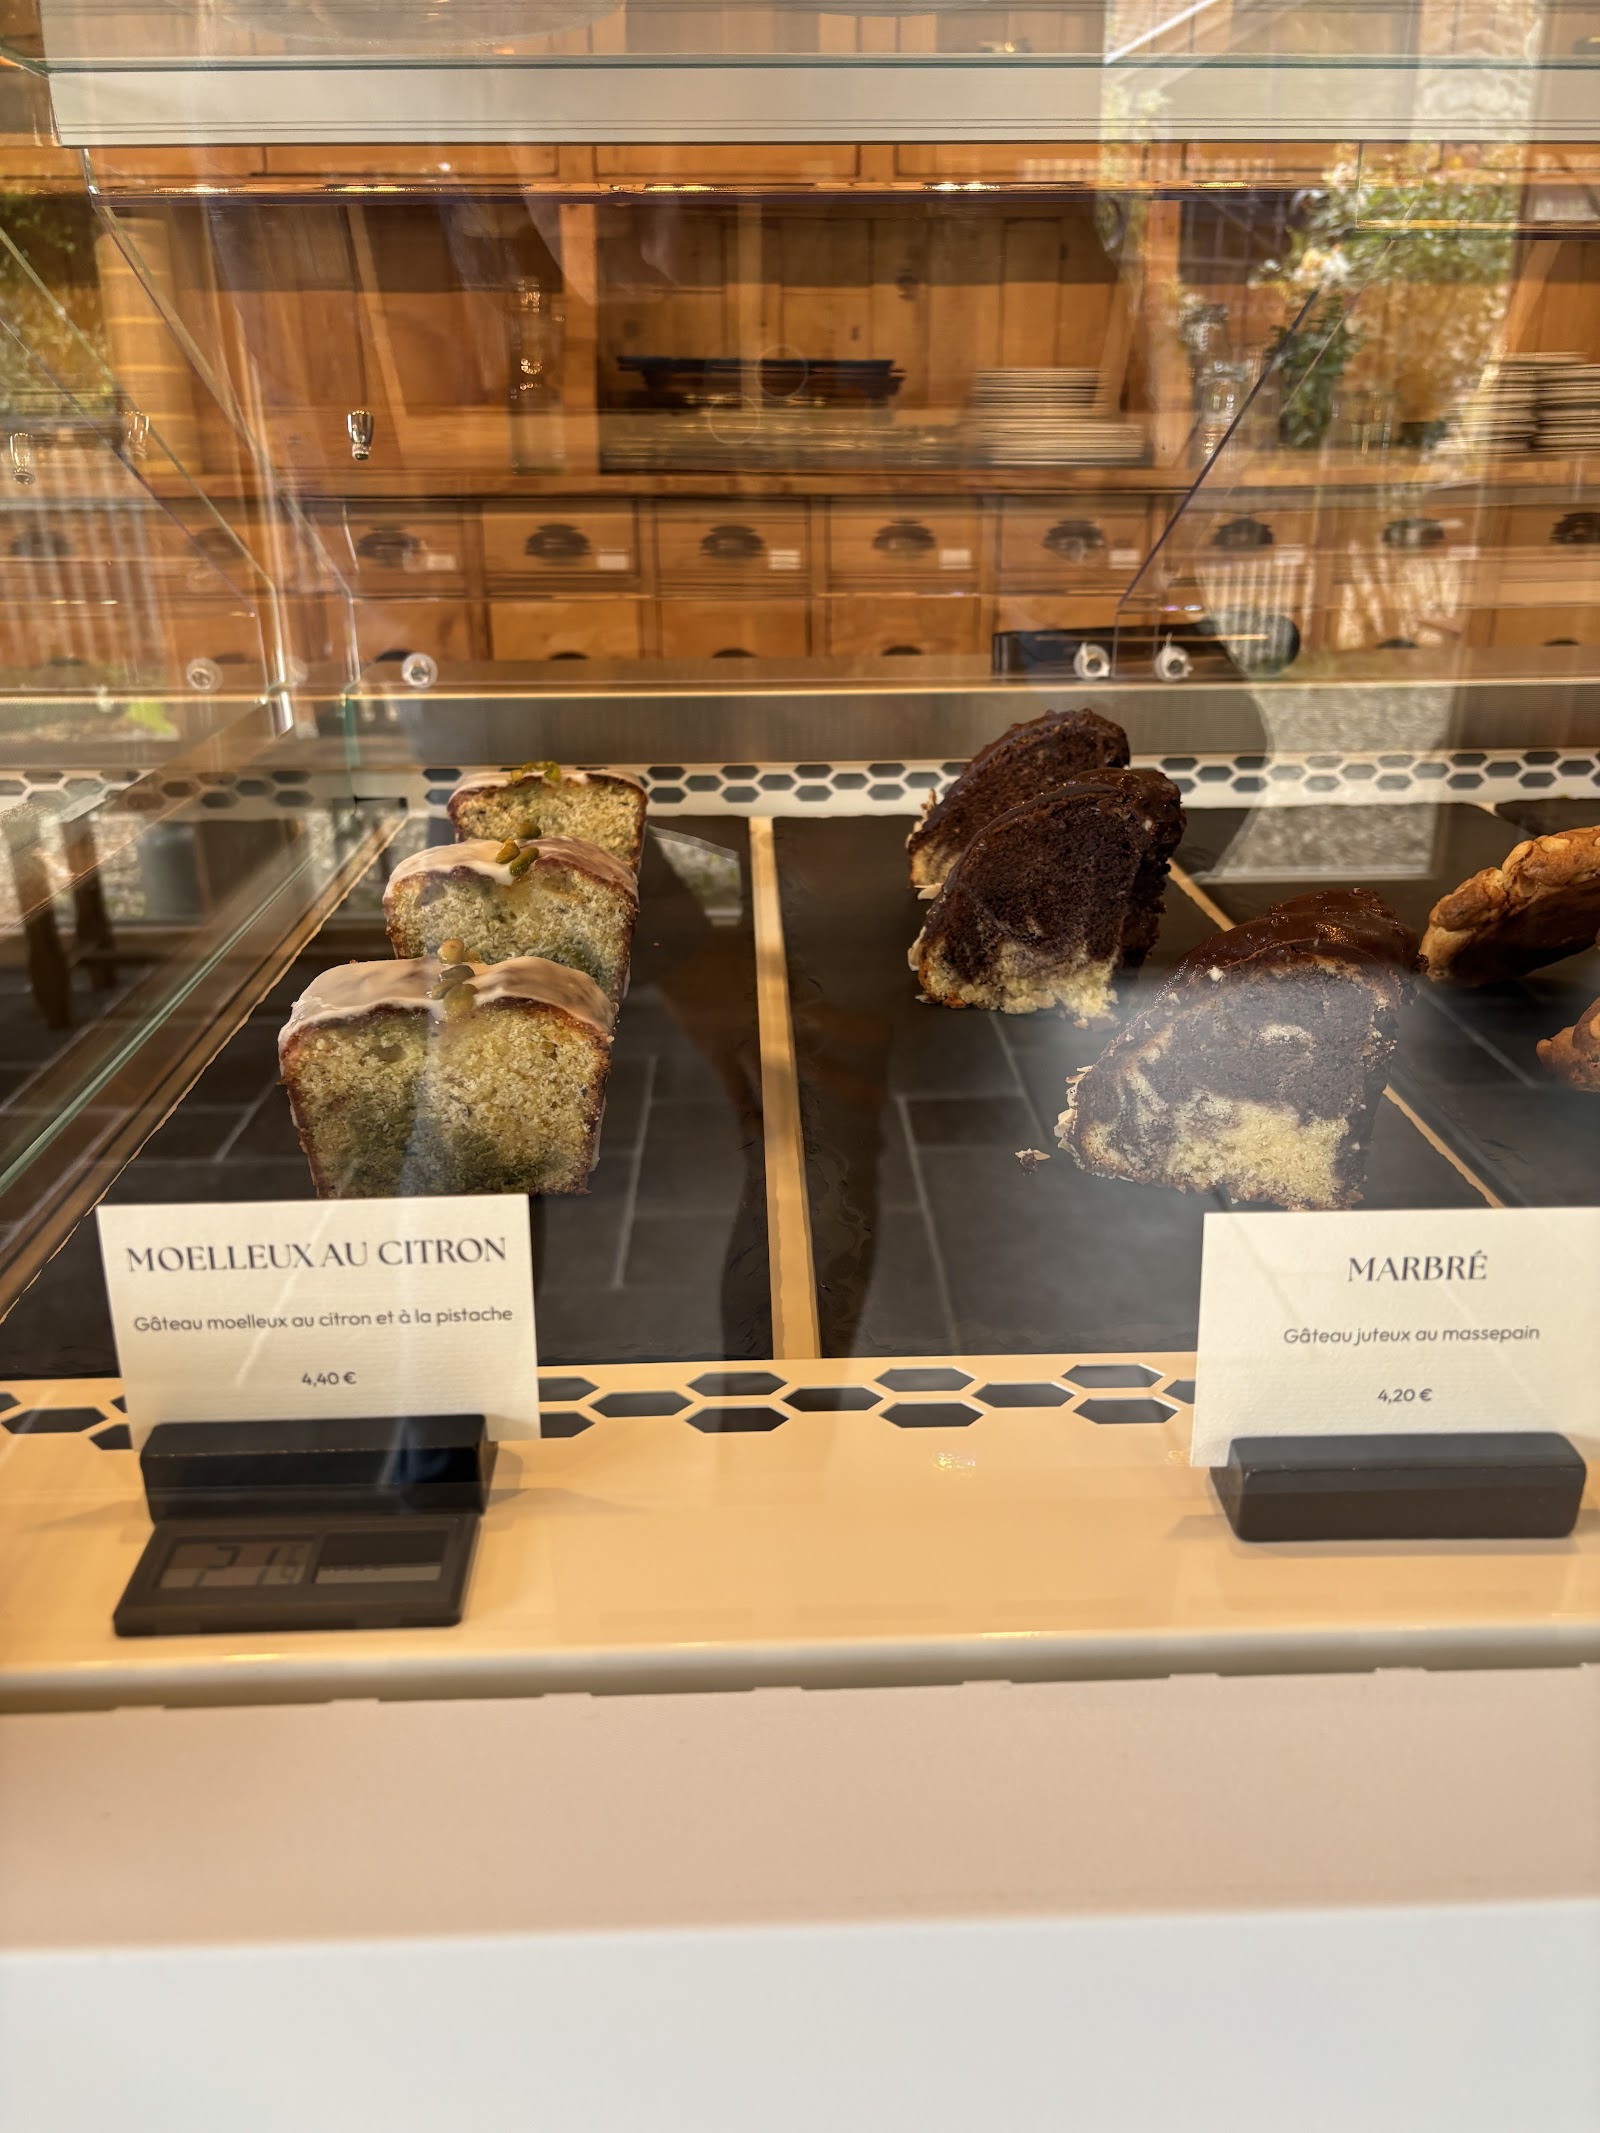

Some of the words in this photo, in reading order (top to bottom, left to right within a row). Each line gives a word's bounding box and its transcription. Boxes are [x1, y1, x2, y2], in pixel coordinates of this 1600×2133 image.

[126, 1243, 315, 1273] MOELLEUX
[320, 1240, 368, 1267] AU
[378, 1236, 507, 1265] CITRON
[1347, 1249, 1489, 1283] MARBRÉ
[133, 1314, 203, 1334] Gâteau
[207, 1313, 287, 1331] moelleux
[292, 1315, 315, 1329] au
[318, 1310, 372, 1328] citron
[376, 1310, 395, 1326] et
[398, 1307, 411, 1326] à
[415, 1307, 432, 1325] la
[435, 1304, 514, 1328] pistache
[1283, 1325, 1352, 1345] Gâteau
[1354, 1325, 1410, 1348] juteux
[1415, 1327, 1438, 1342] au
[1442, 1323, 1541, 1344] massepain
[301, 1370, 340, 1388] 4,40
[343, 1370, 358, 1386] €
[1377, 1386, 1416, 1405] 4,20
[1419, 1386, 1434, 1403] €
